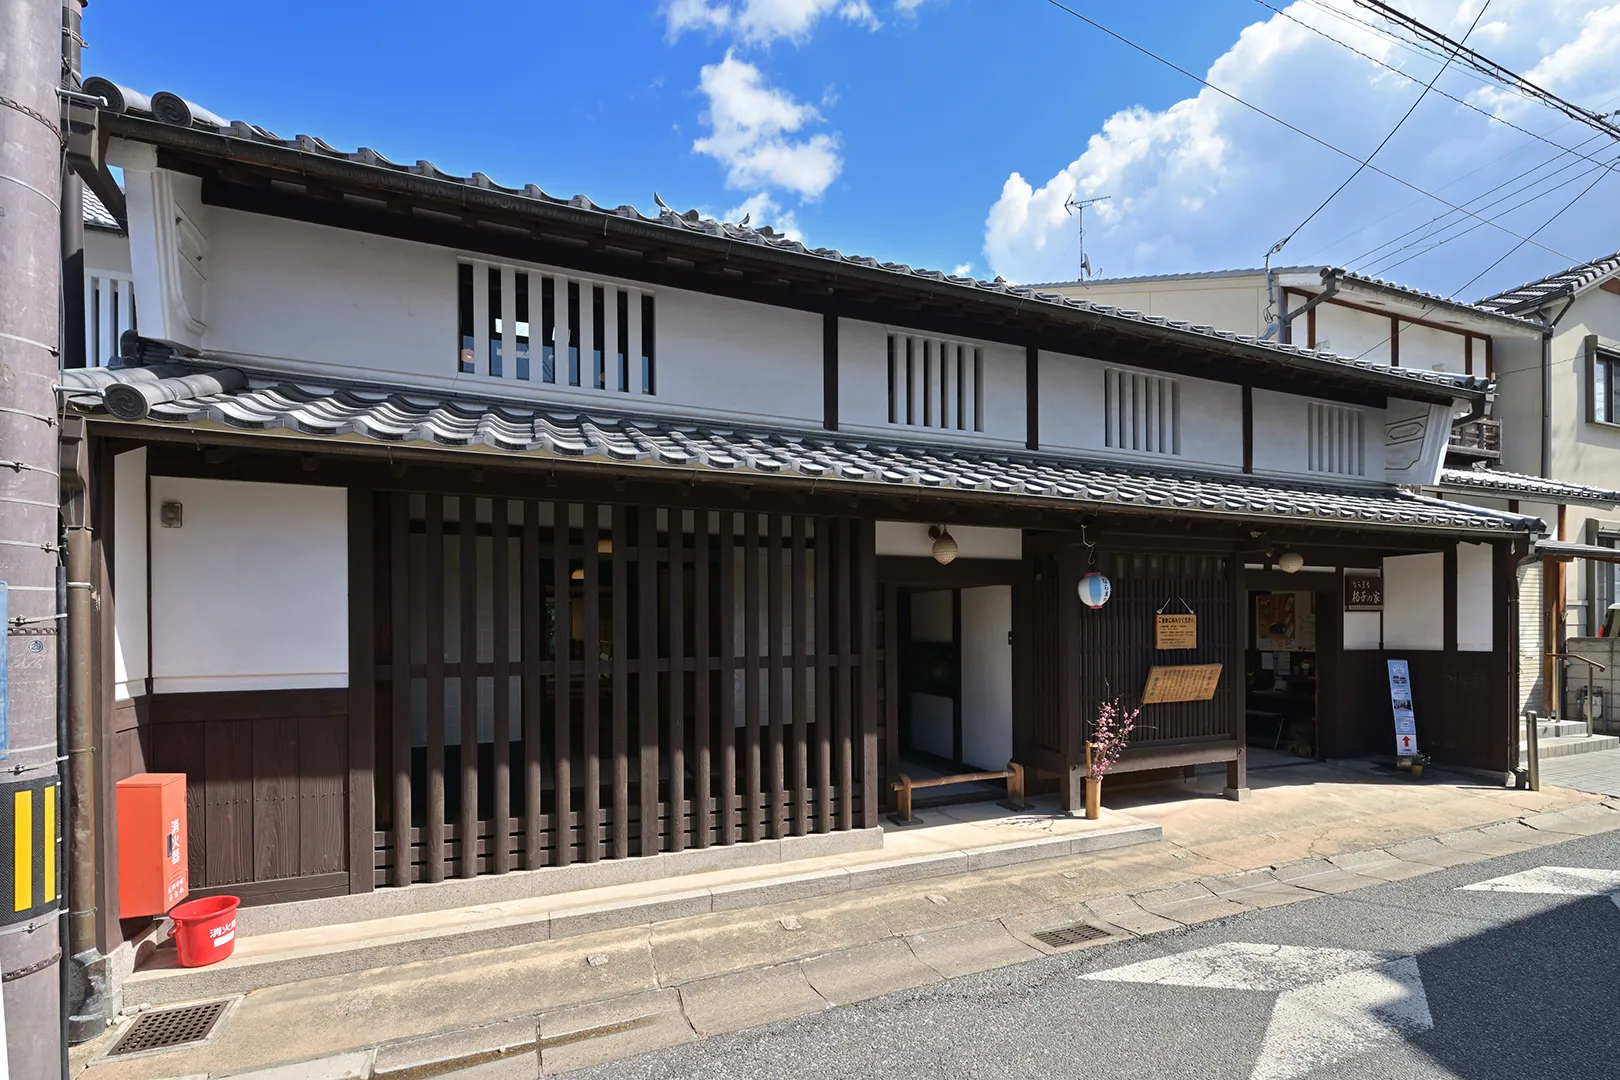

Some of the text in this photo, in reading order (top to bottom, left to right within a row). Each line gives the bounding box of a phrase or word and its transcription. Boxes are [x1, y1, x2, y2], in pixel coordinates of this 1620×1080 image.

[1352, 590, 1381, 604] 格子の家
[171, 818, 180, 865] 消火器
